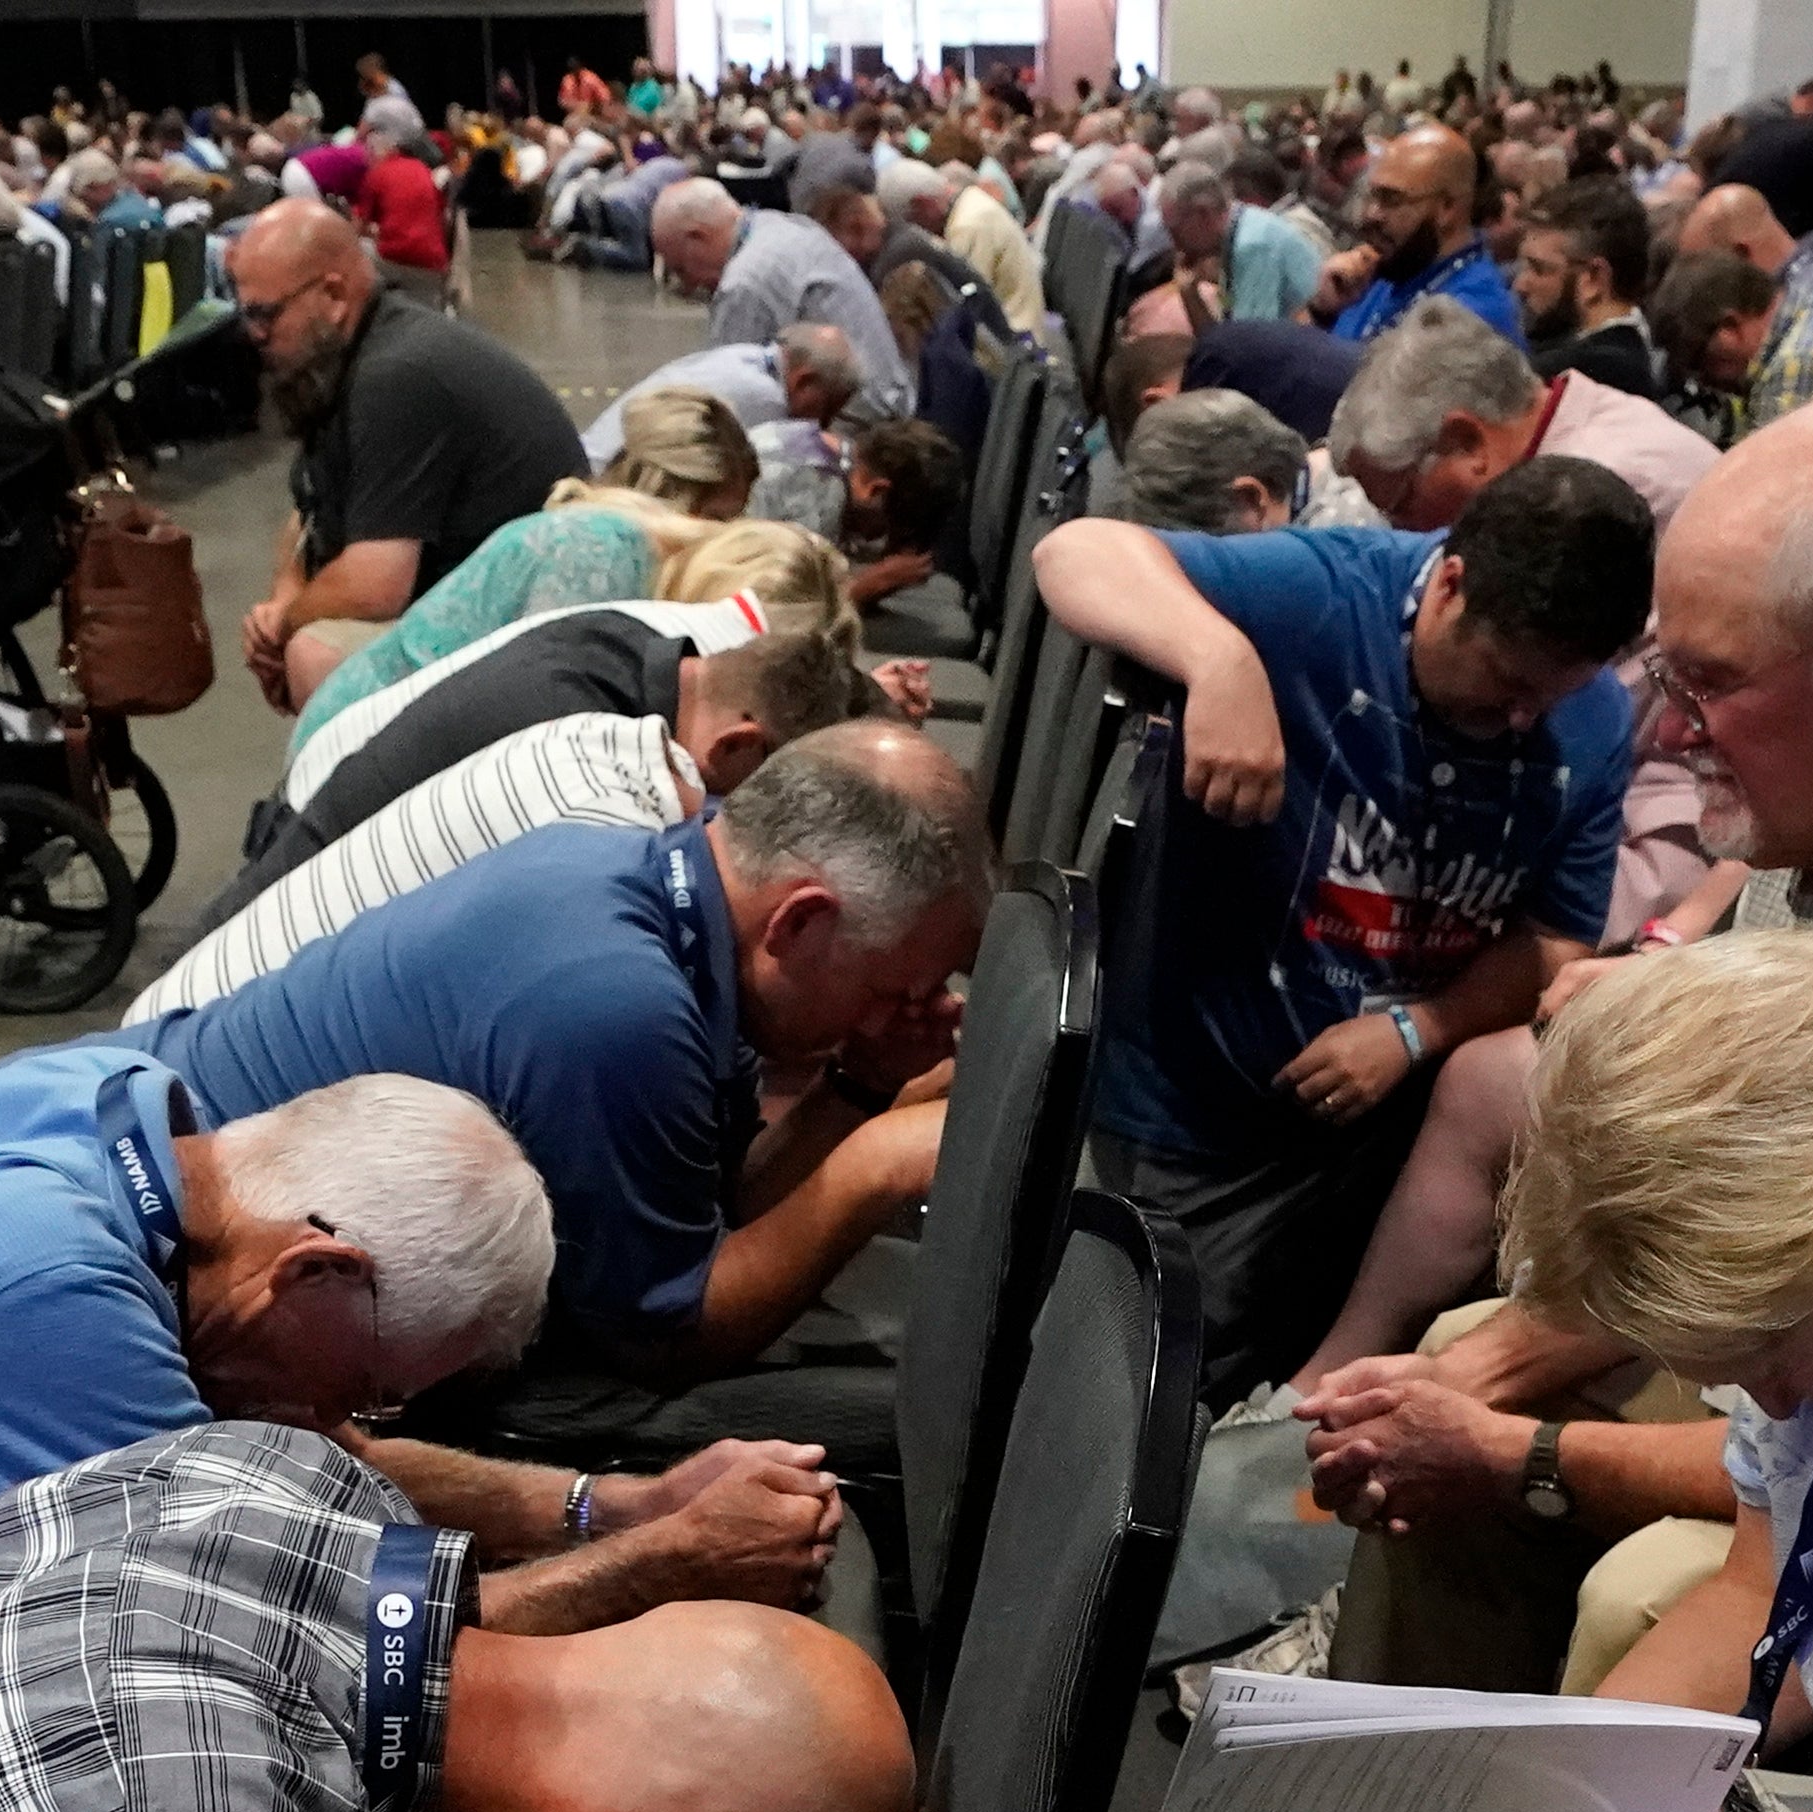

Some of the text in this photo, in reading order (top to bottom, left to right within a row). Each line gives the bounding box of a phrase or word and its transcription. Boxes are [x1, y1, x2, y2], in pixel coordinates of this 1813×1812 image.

[115, 1136, 151, 1192] NAMB
[1777, 1607, 1810, 1640] SBC
[379, 1635, 410, 1771] SBC imb
